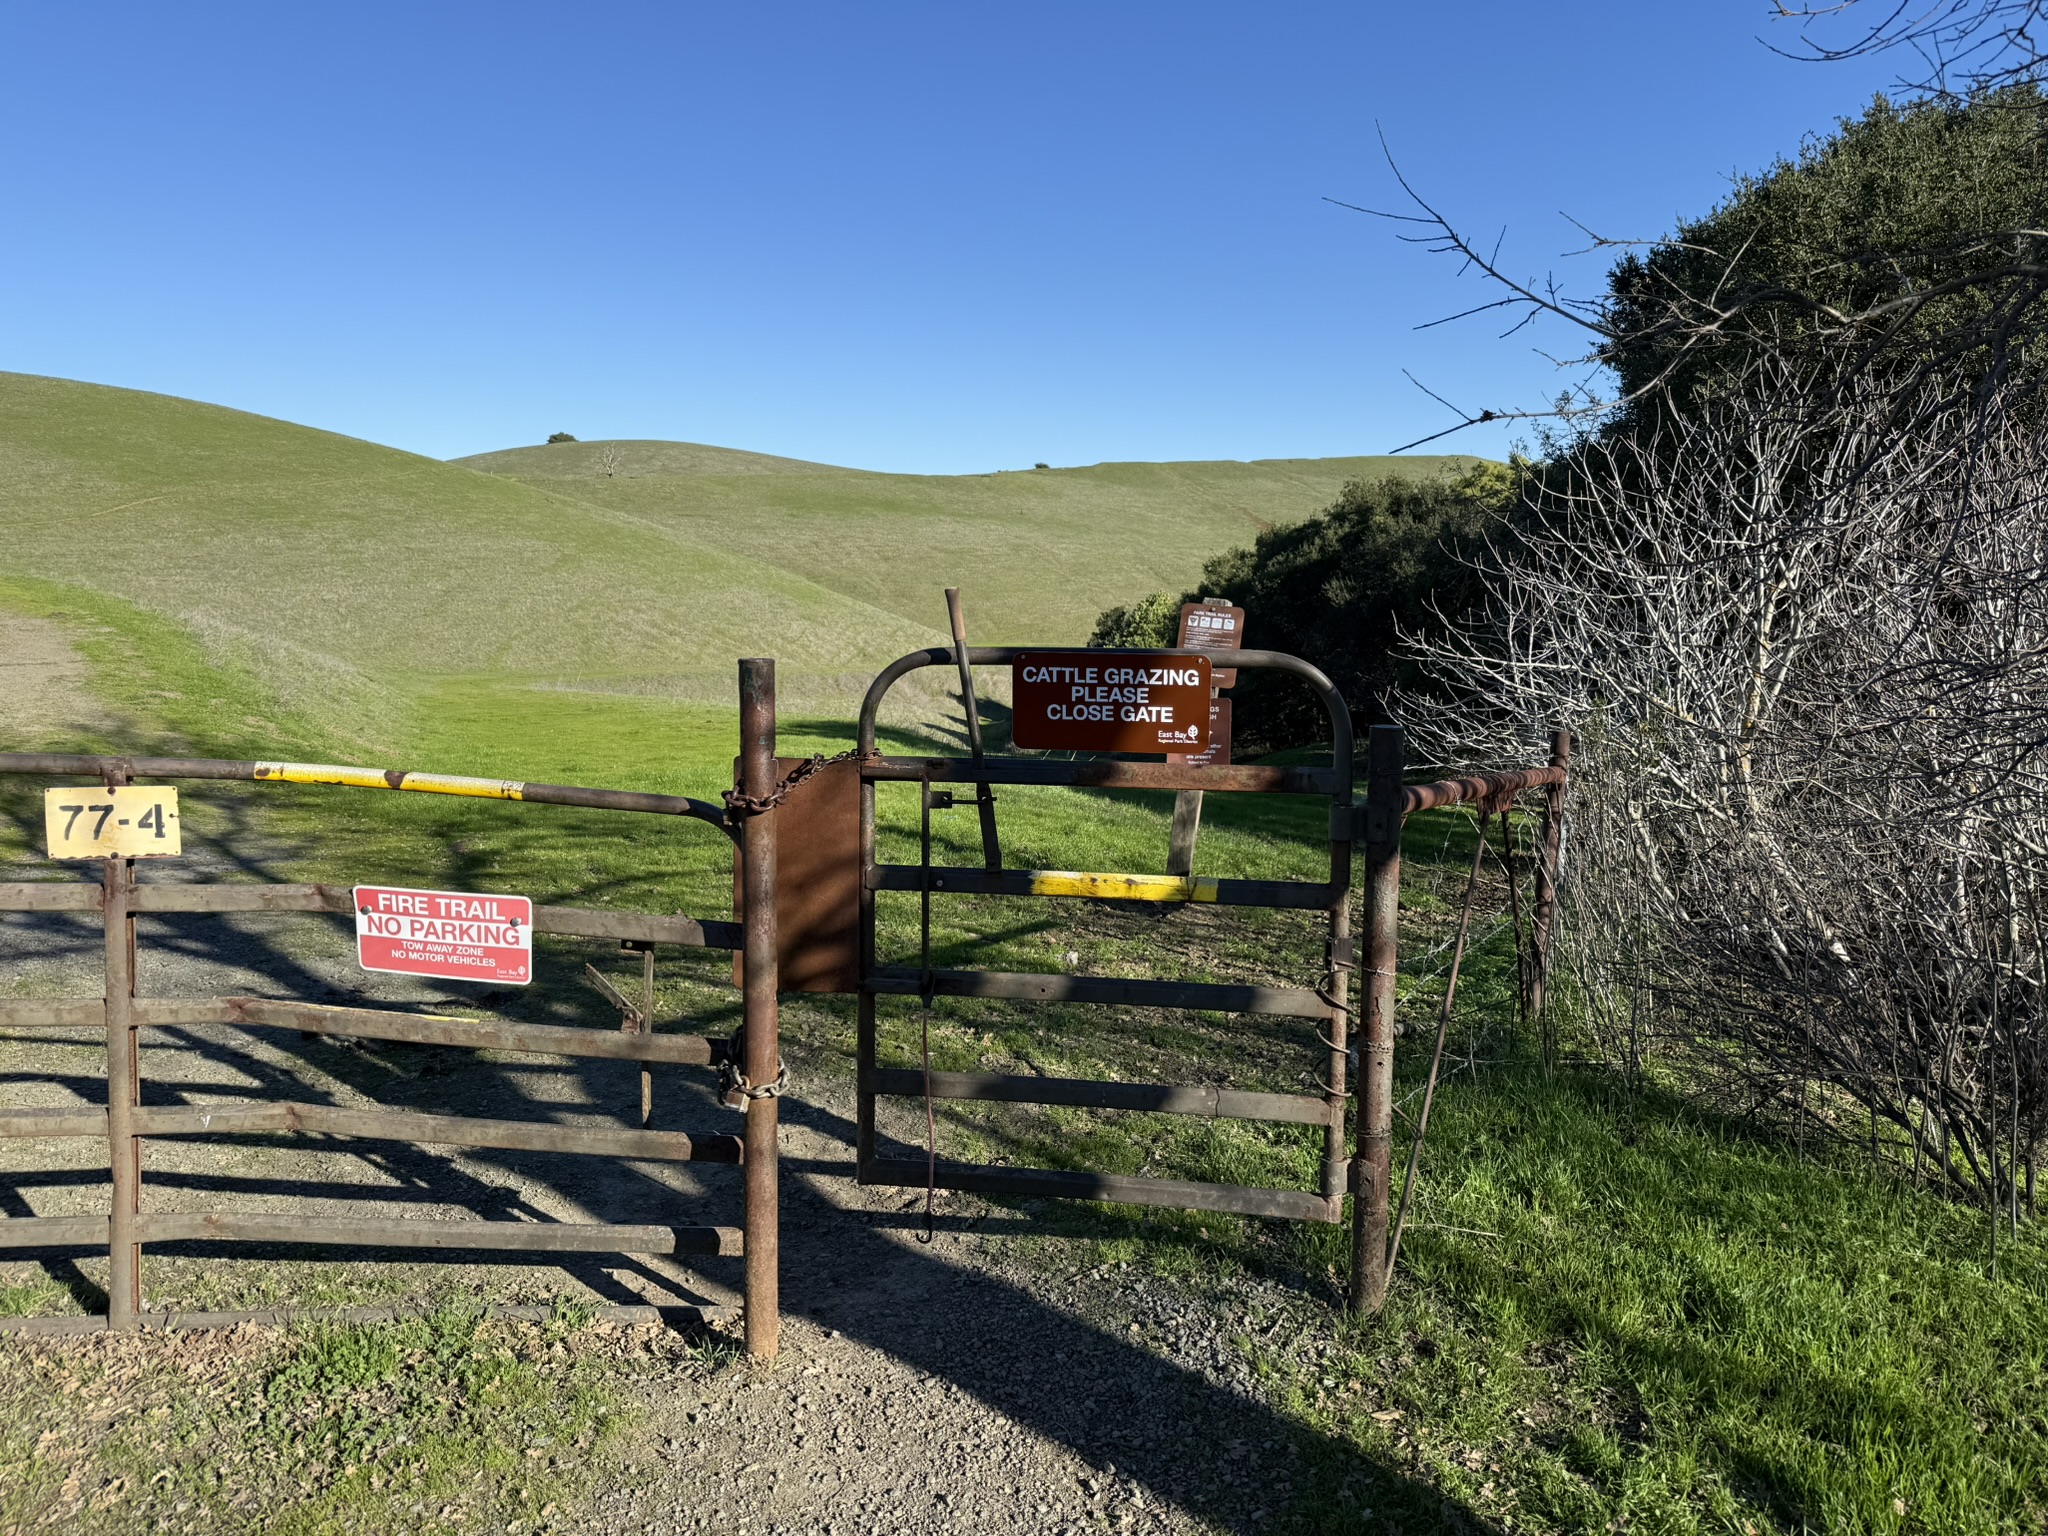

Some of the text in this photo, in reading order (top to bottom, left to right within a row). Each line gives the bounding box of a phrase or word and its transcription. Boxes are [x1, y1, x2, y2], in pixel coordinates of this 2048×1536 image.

[1022, 666, 1200, 686] CATTLE GRAZING
[1072, 686, 1150, 704] PLEASE
[1046, 704, 1174, 722] CLOSE GATE
[1174, 730, 1188, 740] Bay
[59, 804, 165, 840] 77-4
[378, 894, 506, 920] FIRE TRAIL
[367, 916, 520, 946] NO PARKING
[401, 940, 484, 956] TOW AWAY ZONE
[392, 950, 496, 968] NO MOTOR VEHICLES
[508, 968, 518, 976] Bay
